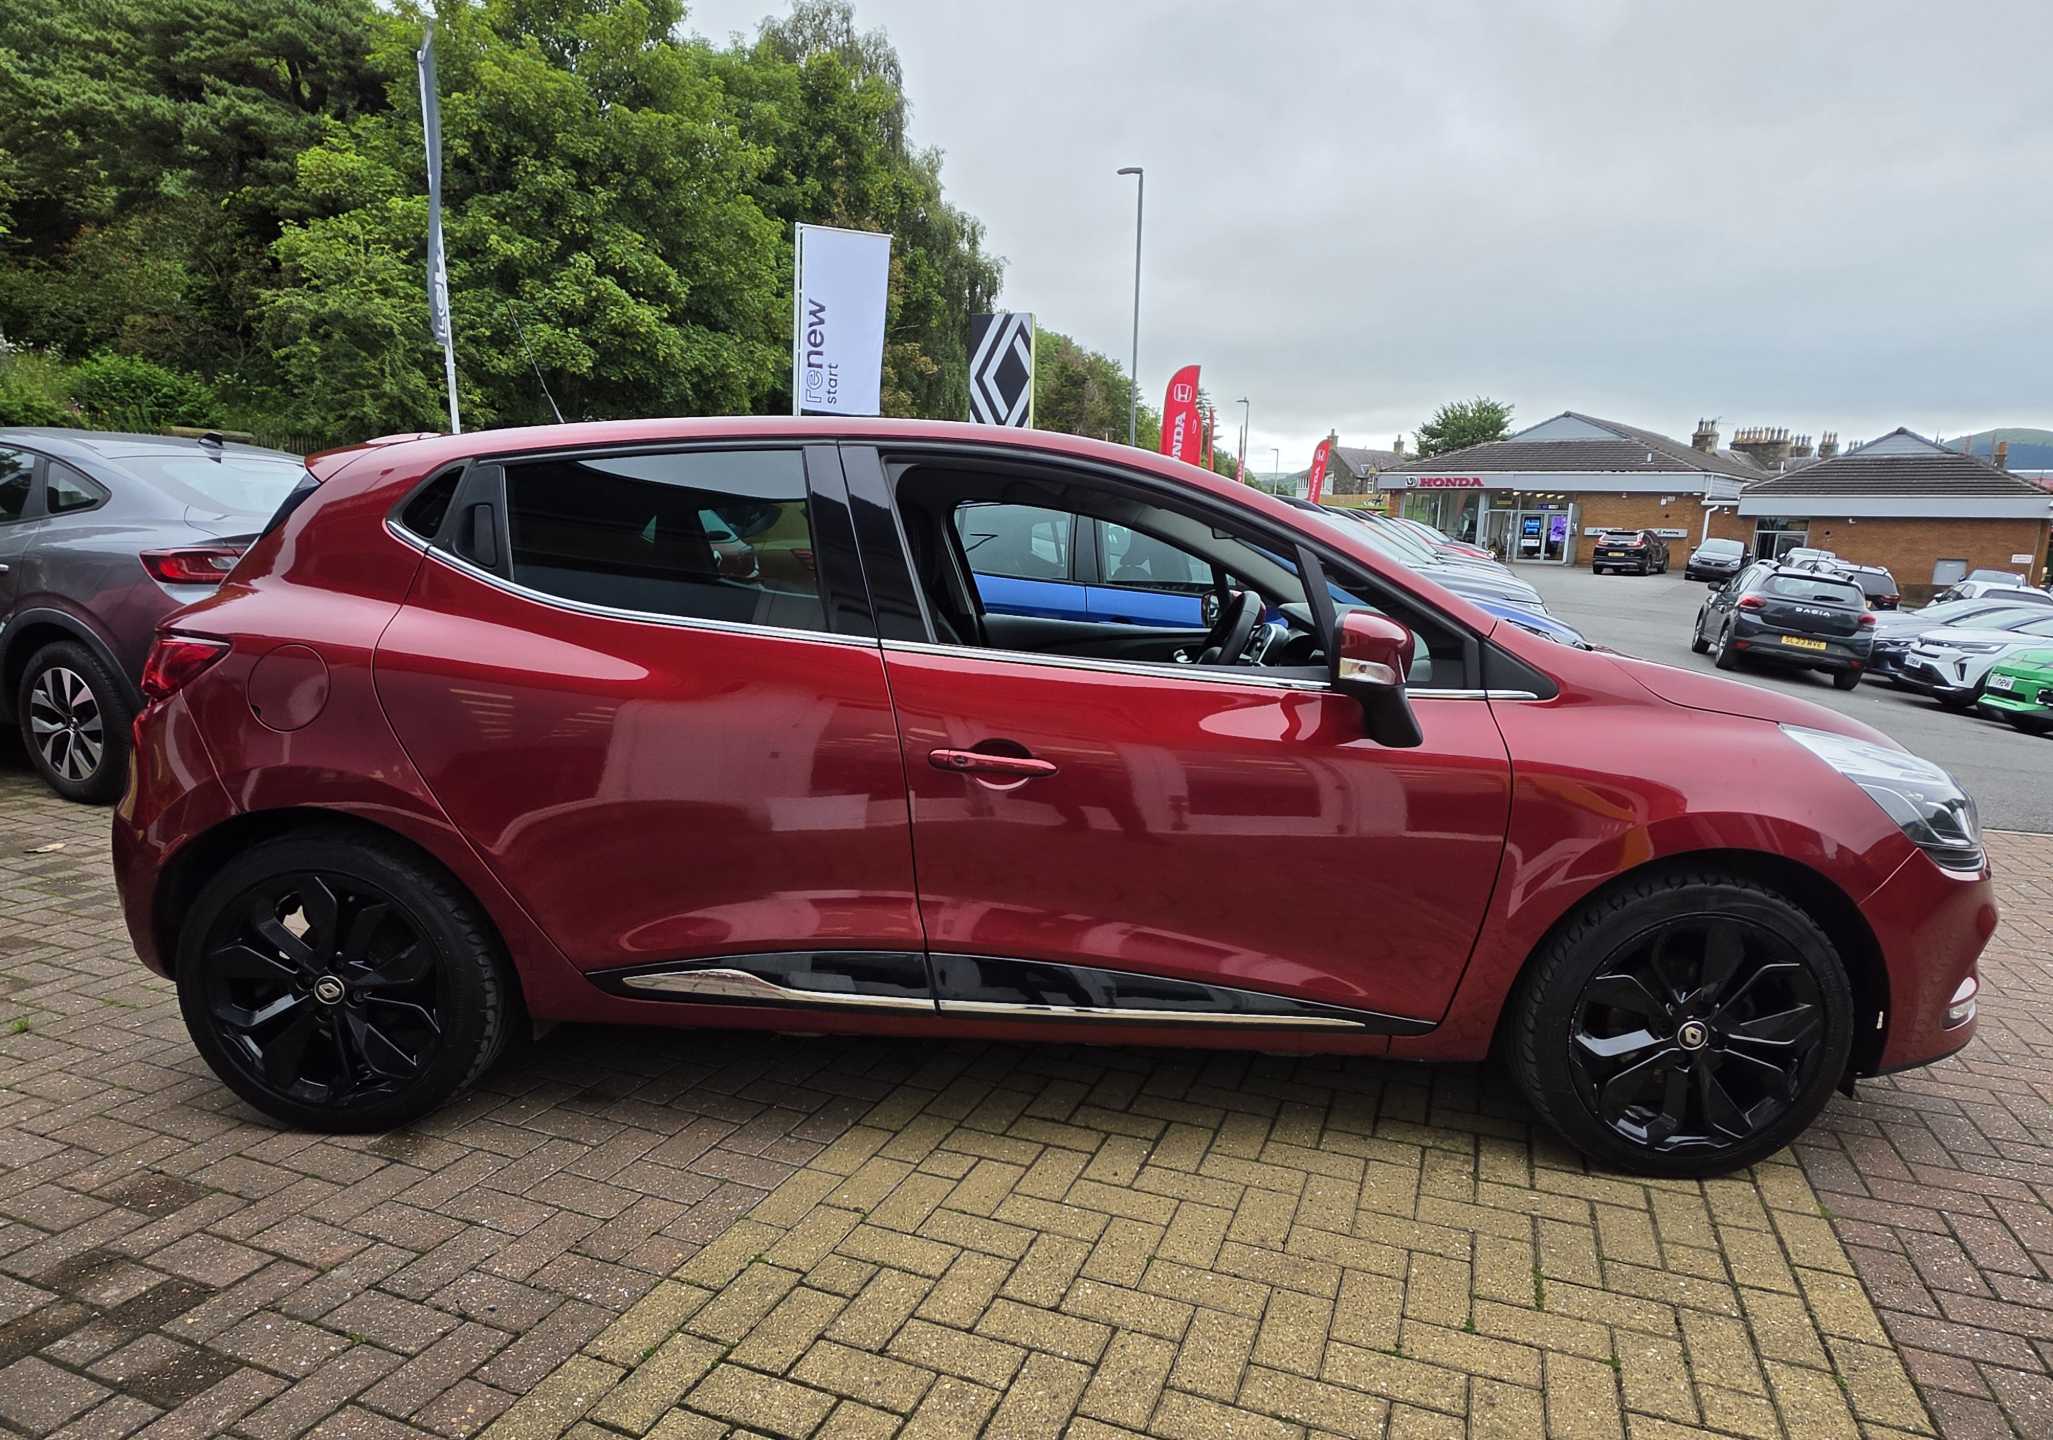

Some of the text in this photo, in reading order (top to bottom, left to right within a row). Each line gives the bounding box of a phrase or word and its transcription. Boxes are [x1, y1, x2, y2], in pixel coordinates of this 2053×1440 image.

[805, 298, 826, 403] renew
[826, 362, 839, 405] start
[1171, 411, 1187, 461] NDA
[1419, 477, 1485, 488] HONDA
